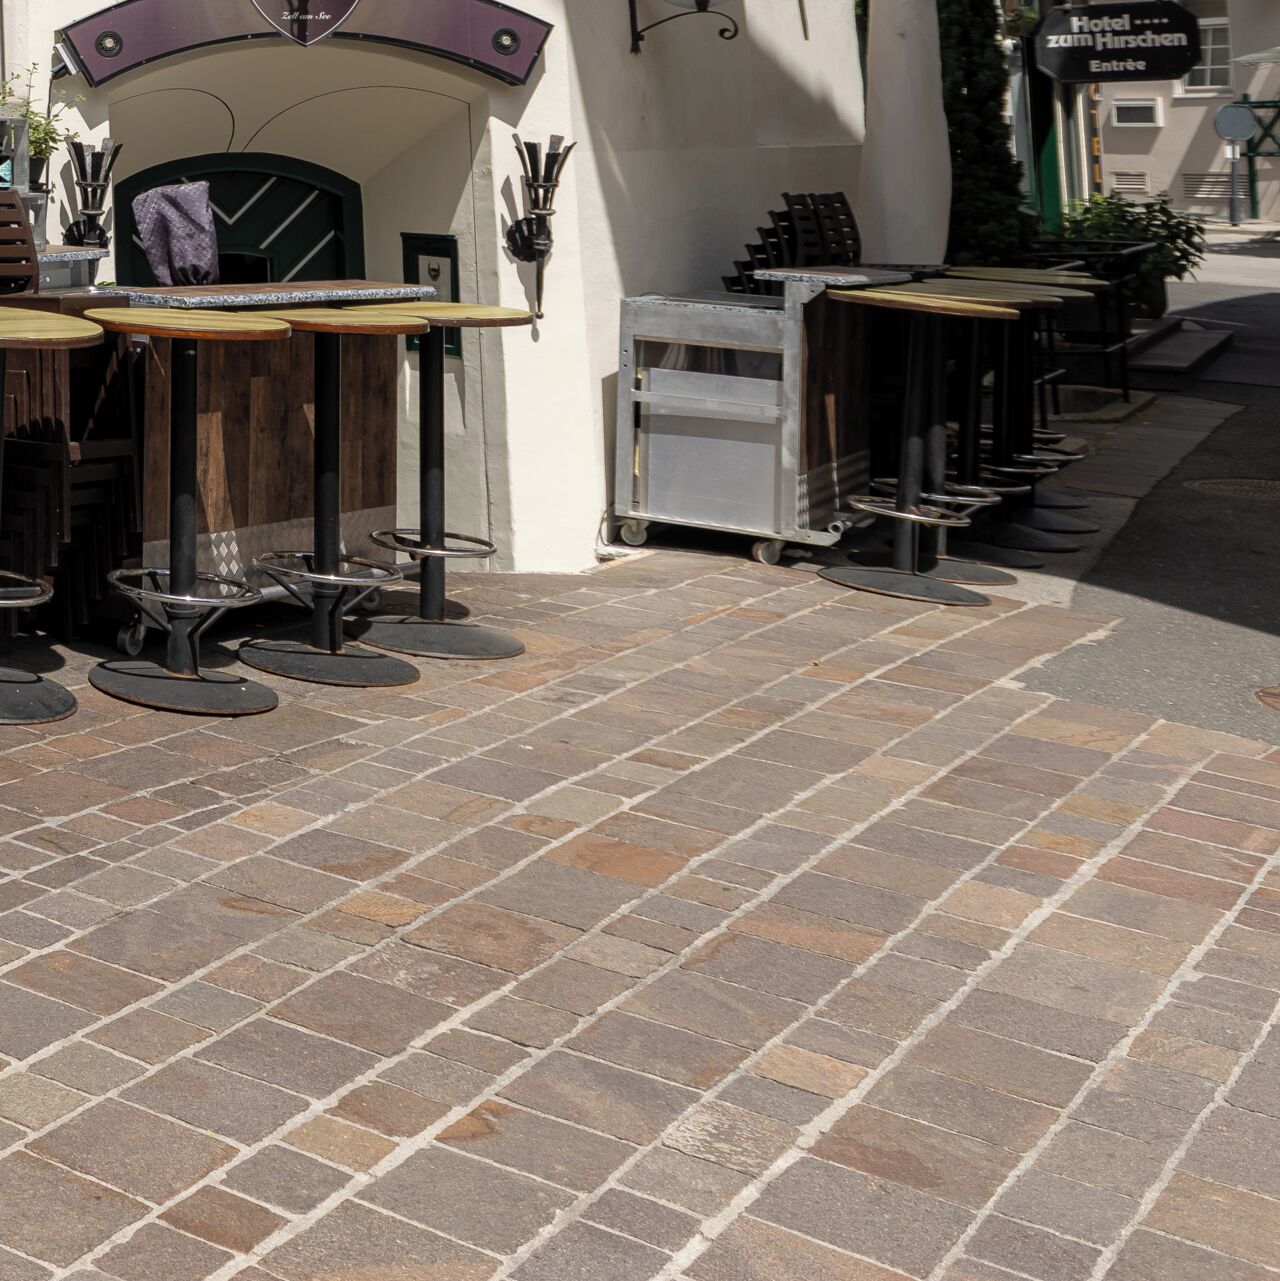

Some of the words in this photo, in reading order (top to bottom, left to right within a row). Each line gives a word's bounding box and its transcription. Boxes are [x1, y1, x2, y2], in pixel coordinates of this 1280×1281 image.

[281, 11, 298, 20] Zell
[315, 11, 332, 20] See
[1070, 14, 1131, 33] Hotel
[1046, 33, 1093, 48] zum
[1095, 30, 1188, 51] Hirschen
[1088, 82, 1103, 183] OTEL
